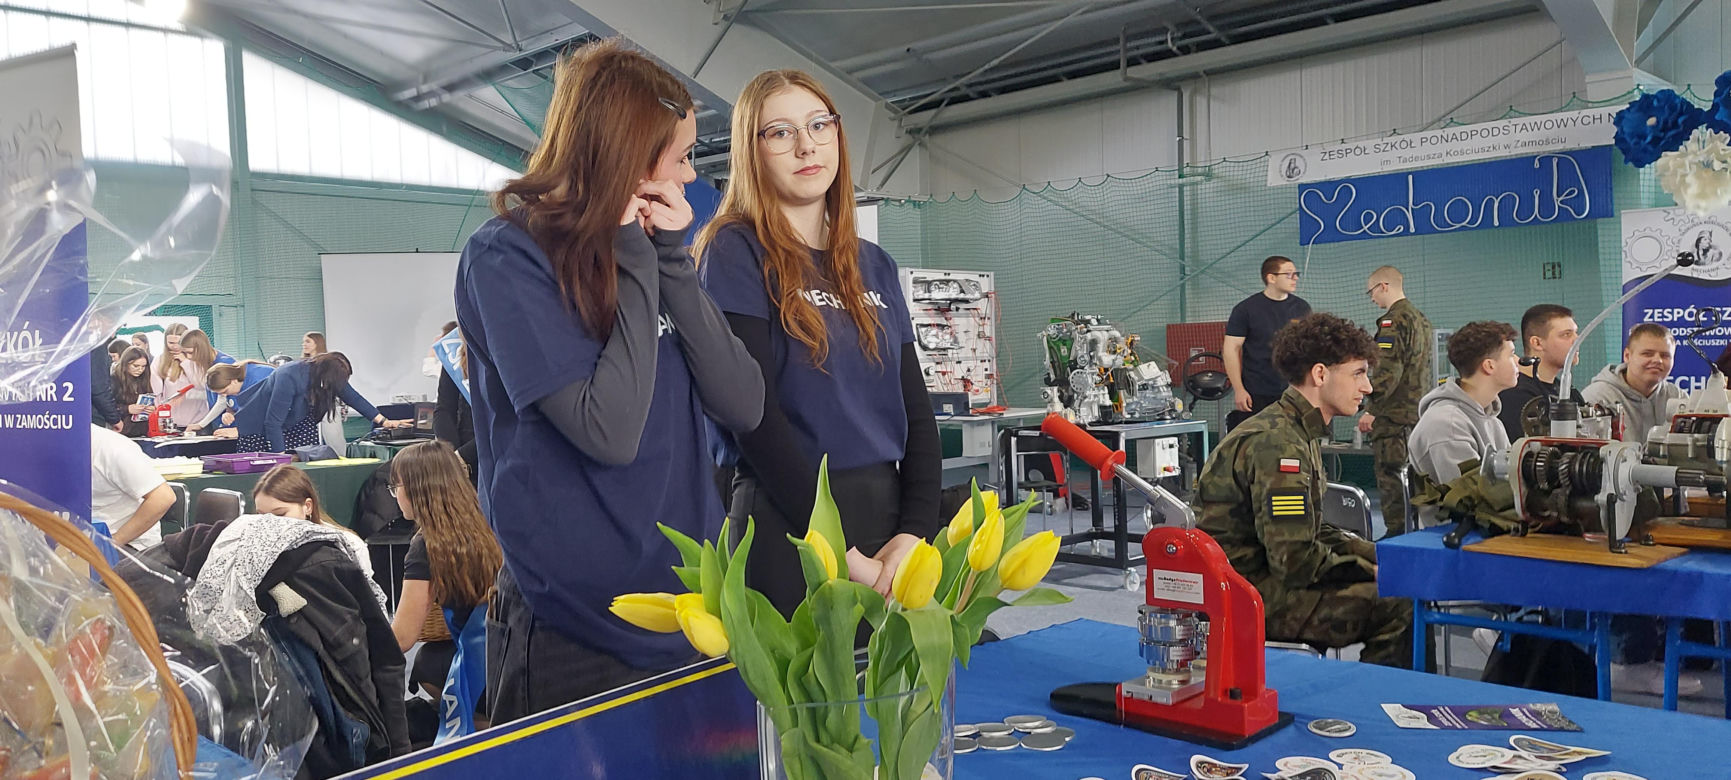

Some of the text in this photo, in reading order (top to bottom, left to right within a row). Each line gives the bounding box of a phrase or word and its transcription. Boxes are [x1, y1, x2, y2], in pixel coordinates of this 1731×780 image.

[1320, 144, 1370, 161] ZESPÓŁ
[1373, 138, 1417, 154] SZKÓŁ
[1420, 113, 1603, 149] PONADPODSTAWOWYCH
[1397, 151, 1443, 164] Tadeusza
[1445, 142, 1501, 158] Kościuszki
[1514, 135, 1567, 149] Zamościu
[36, 382, 58, 402] NR
[62, 381, 75, 402] 2
[4, 414, 15, 429] W
[16, 411, 73, 430] ZAMOŚCIU
